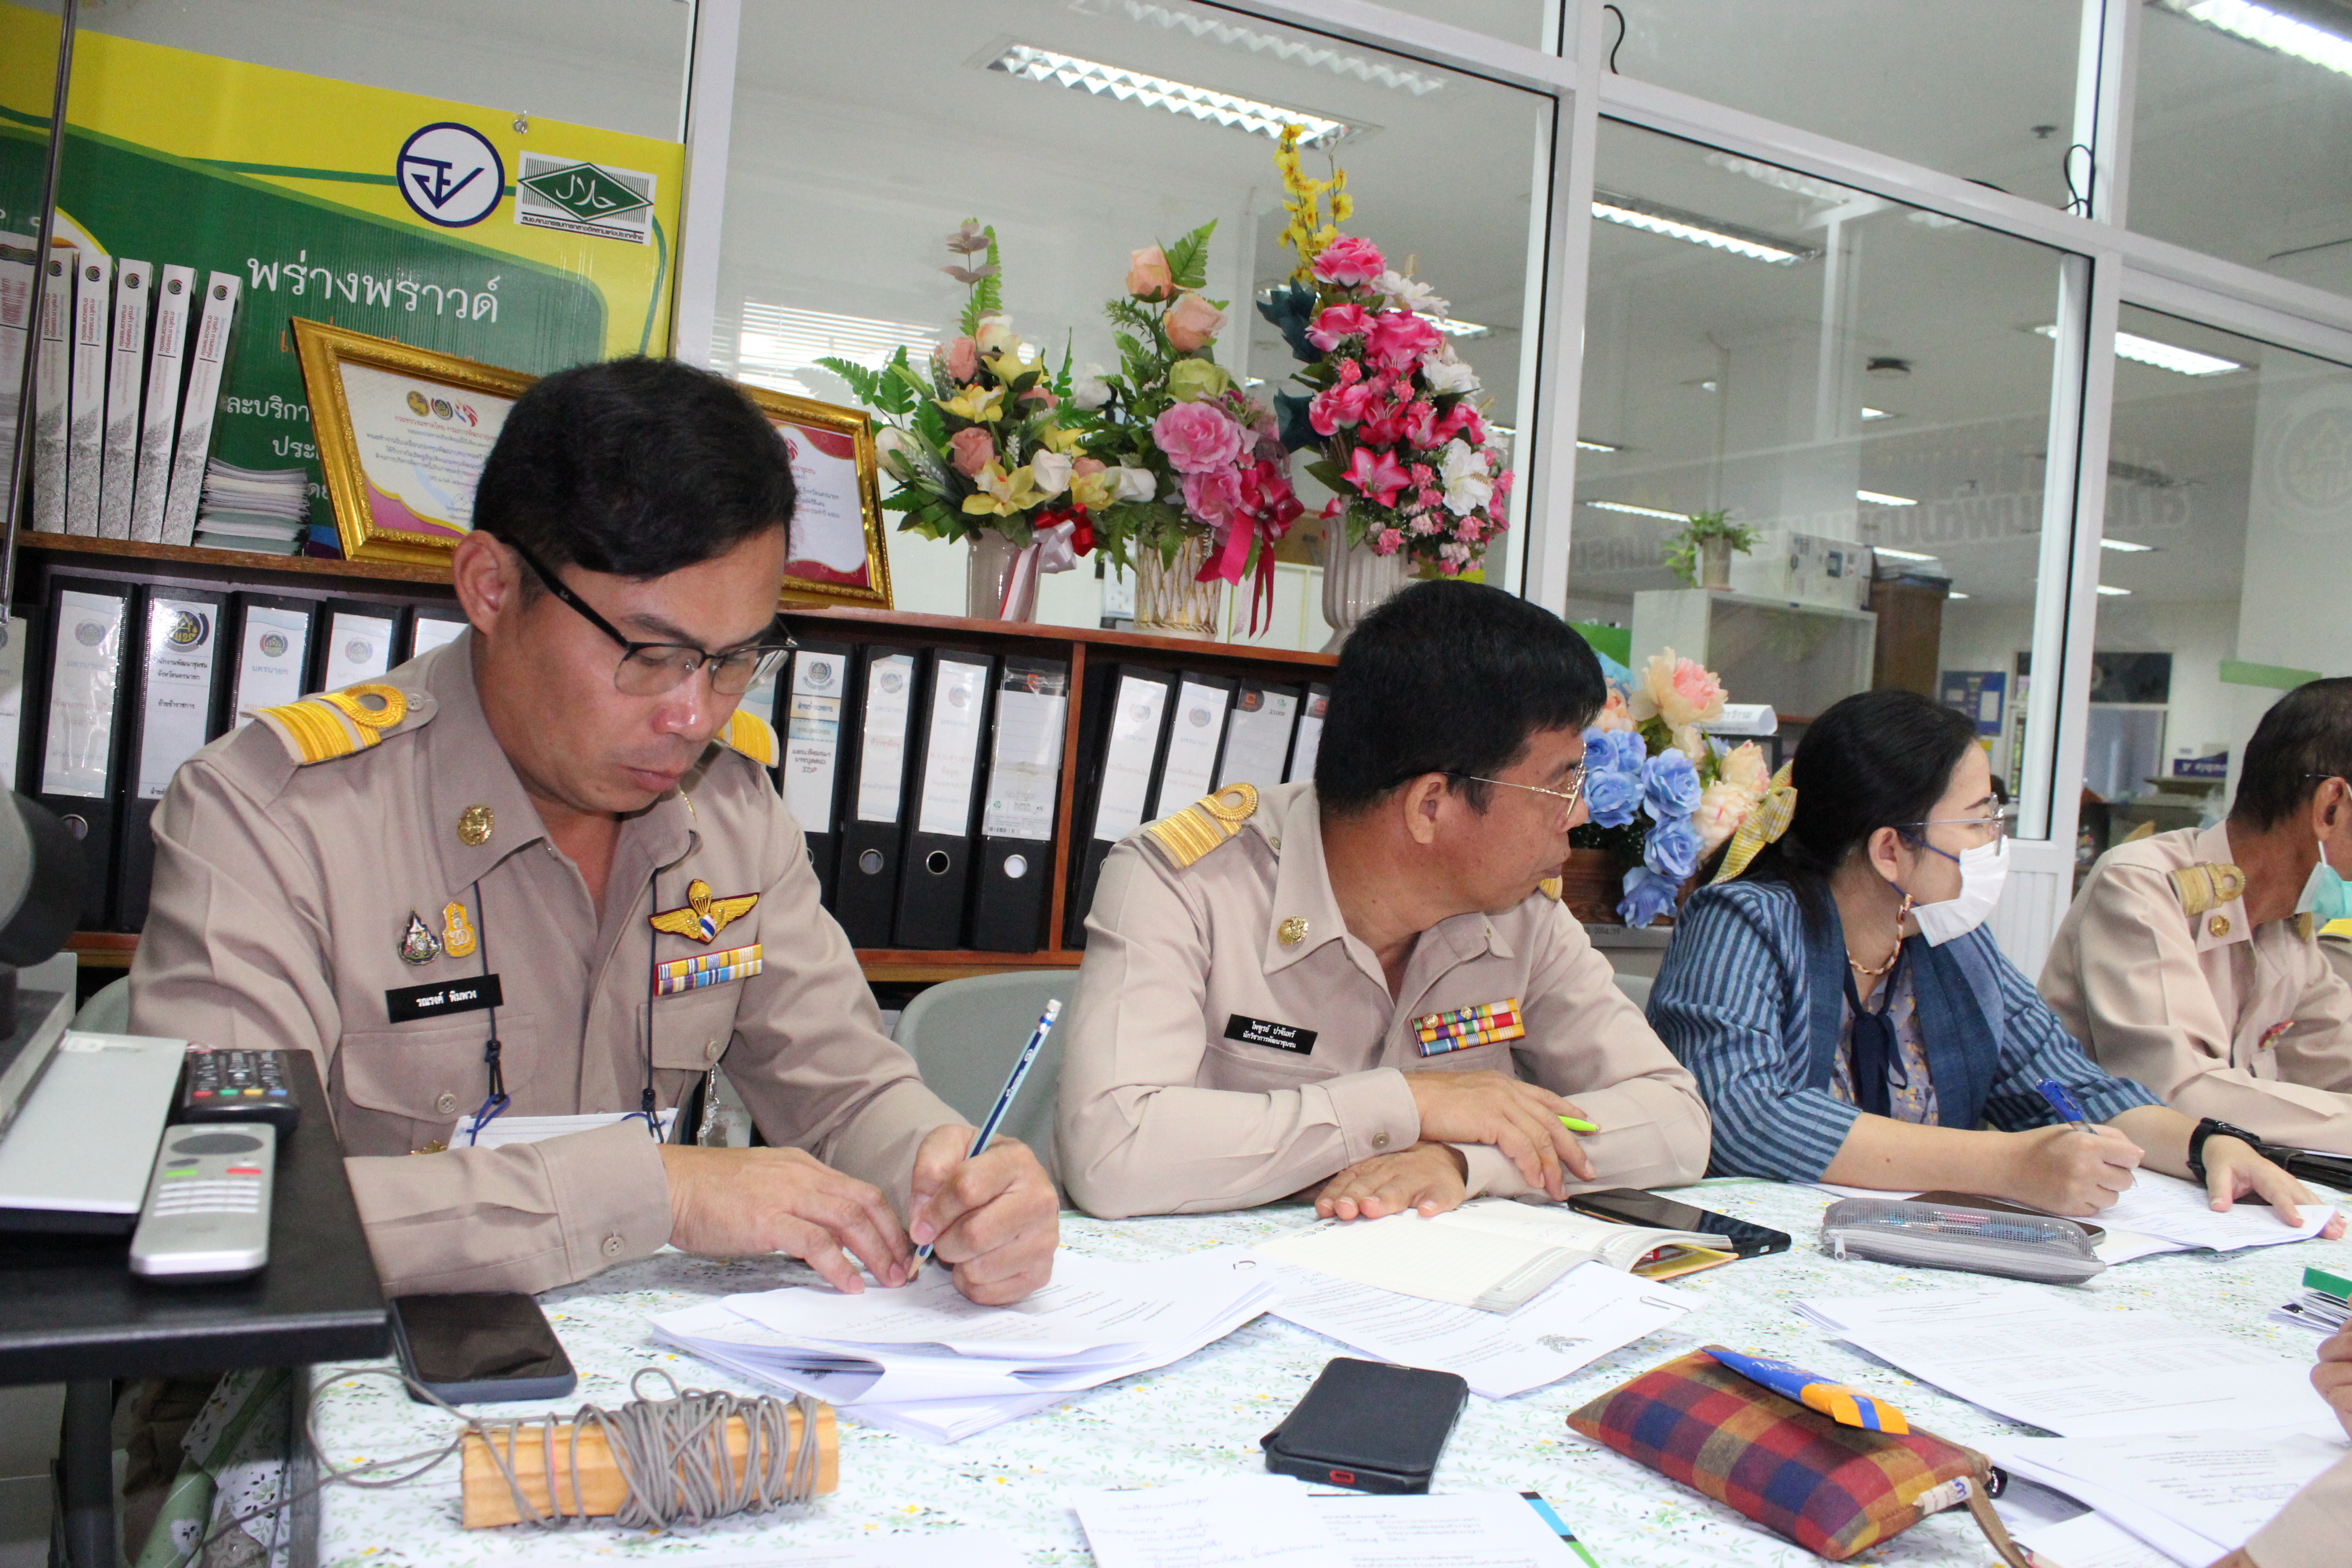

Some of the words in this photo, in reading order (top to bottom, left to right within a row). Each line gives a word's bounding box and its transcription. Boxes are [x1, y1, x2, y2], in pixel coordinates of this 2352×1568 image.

[247, 250, 501, 323] พร่างพราวด์
[272, 436, 319, 460] ประ
[154, 656, 208, 670] นักงานพัฒนาชุมชน
[252, 663, 289, 676] นครนายก
[1243, 1031, 1296, 1049] นักวิชาการพัฒนาชุมชน
